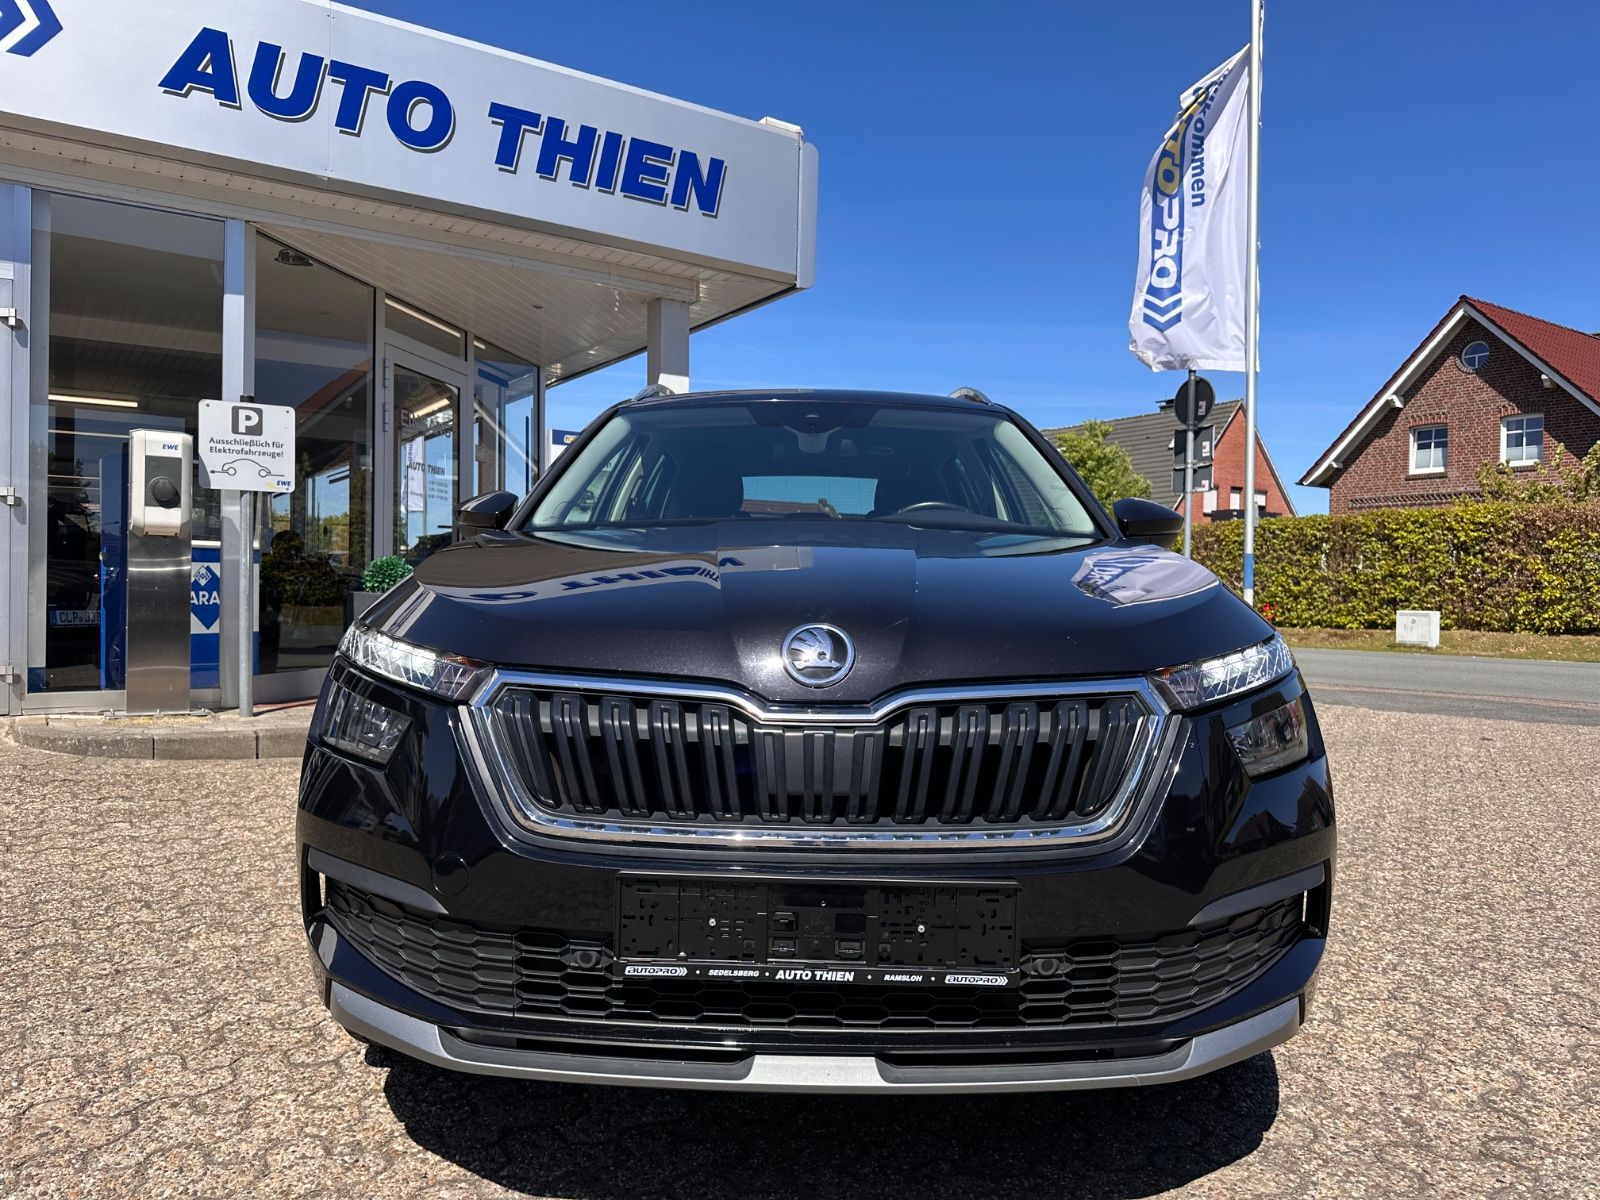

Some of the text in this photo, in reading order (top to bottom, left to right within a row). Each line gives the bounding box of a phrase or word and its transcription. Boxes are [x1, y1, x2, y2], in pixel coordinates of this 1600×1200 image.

[158, 27, 727, 217] AUTO THIEN
[238, 408, 259, 434] P
[162, 443, 179, 451] EWE
[209, 437, 285, 449] Ausschließlich für
[209, 446, 284, 459] Elektrofahrzeuge!
[408, 461, 445, 476] AUTO THIEN
[60, 612, 78, 623] CLP
[708, 969, 760, 977] SEDELSBERG
[775, 970, 812, 980] AUTO
[814, 971, 855, 981] THIEN
[883, 974, 923, 982] RAMSLOH
